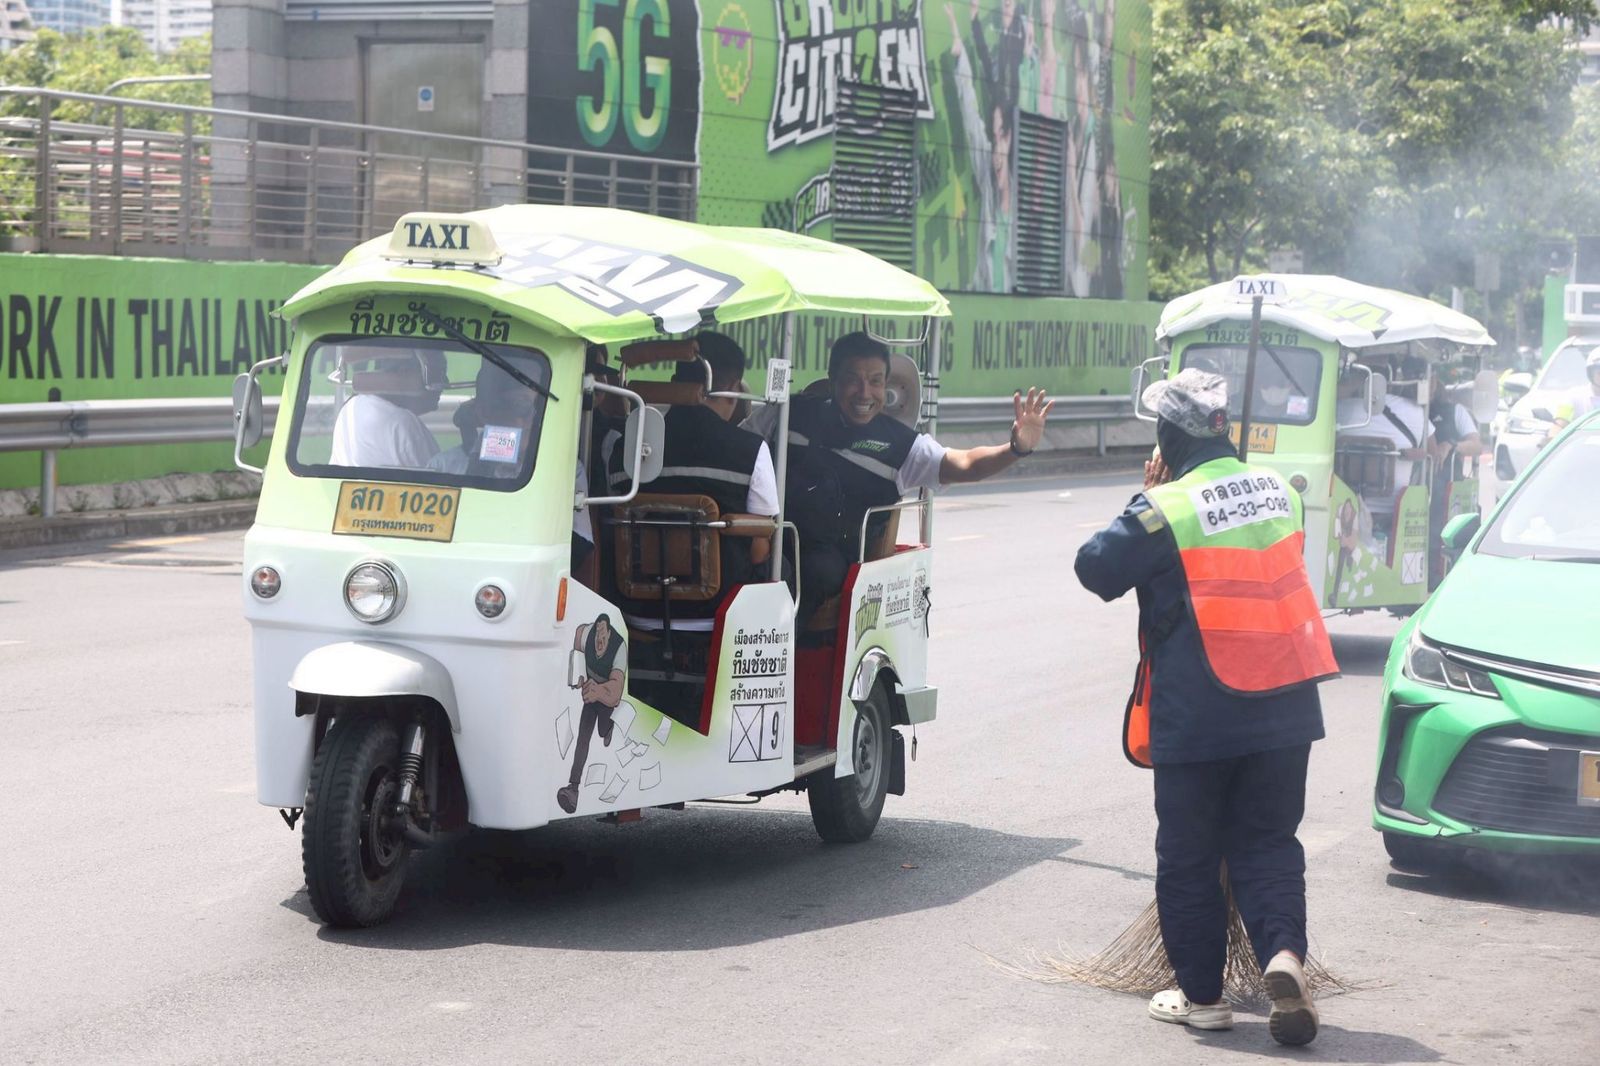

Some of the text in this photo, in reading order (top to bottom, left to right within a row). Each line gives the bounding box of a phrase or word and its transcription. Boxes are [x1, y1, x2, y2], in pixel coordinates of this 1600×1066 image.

[576, 0, 672, 152] 5G
[404, 222, 470, 250] TAXI
[1236, 280, 1275, 295] TAXI
[0, 294, 63, 379] RK
[76, 296, 116, 379] IN
[1004, 320, 1071, 369] NETWORK
[1075, 321, 1088, 368] IN
[1091, 321, 1147, 368] THAILAND
[350, 486, 453, 517] สก 1020
[352, 518, 435, 532] กรุงเทพมหานคร
[732, 648, 787, 675] ทีมชัชชาติ
[730, 681, 785, 700] สร้างความหวัง
[771, 711, 780, 750] 9
